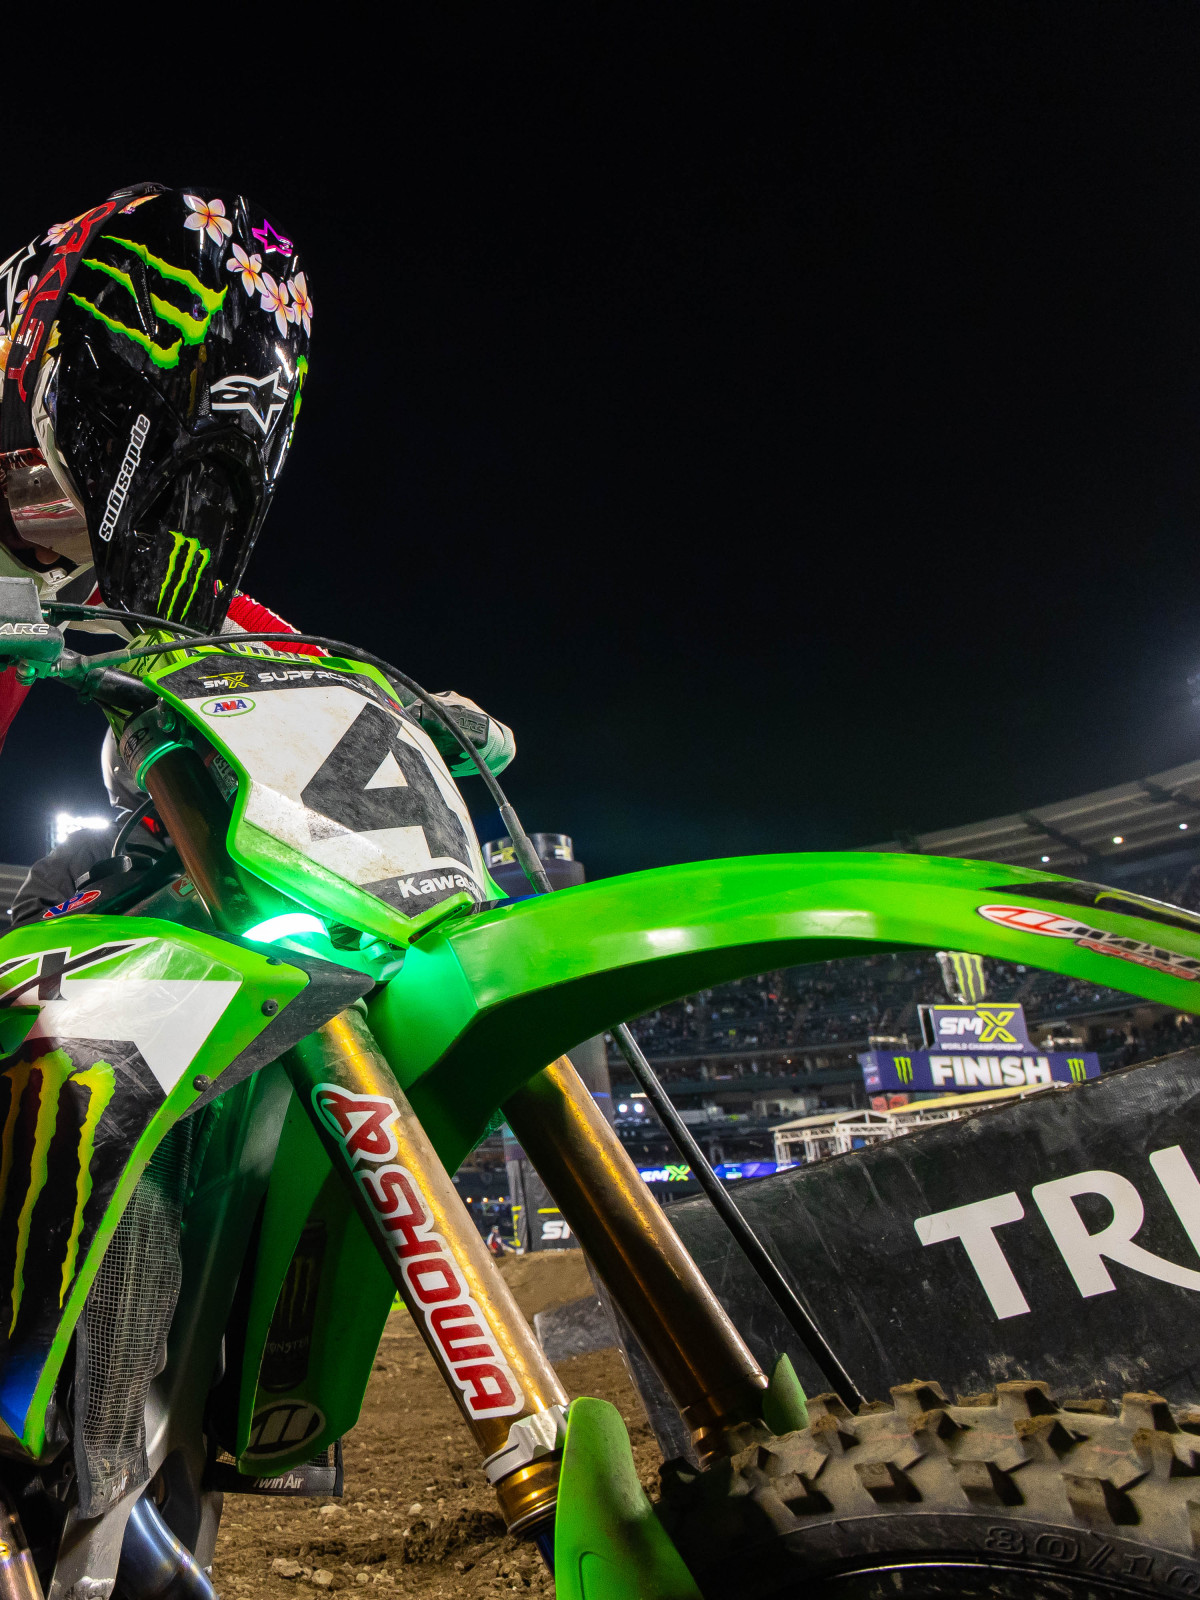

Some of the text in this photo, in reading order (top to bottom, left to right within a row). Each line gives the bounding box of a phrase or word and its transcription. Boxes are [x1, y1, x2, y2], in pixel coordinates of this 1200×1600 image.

[98, 412, 151, 543] apdesigns
[203, 674, 249, 689] SMX
[212, 699, 248, 714] AMA
[301, 702, 474, 873] 4
[938, 1010, 1018, 1043] SMX
[929, 1055, 1052, 1087] FINISH
[361, 1168, 518, 1413] SHOWA
[284, 1474, 304, 1489] Air
